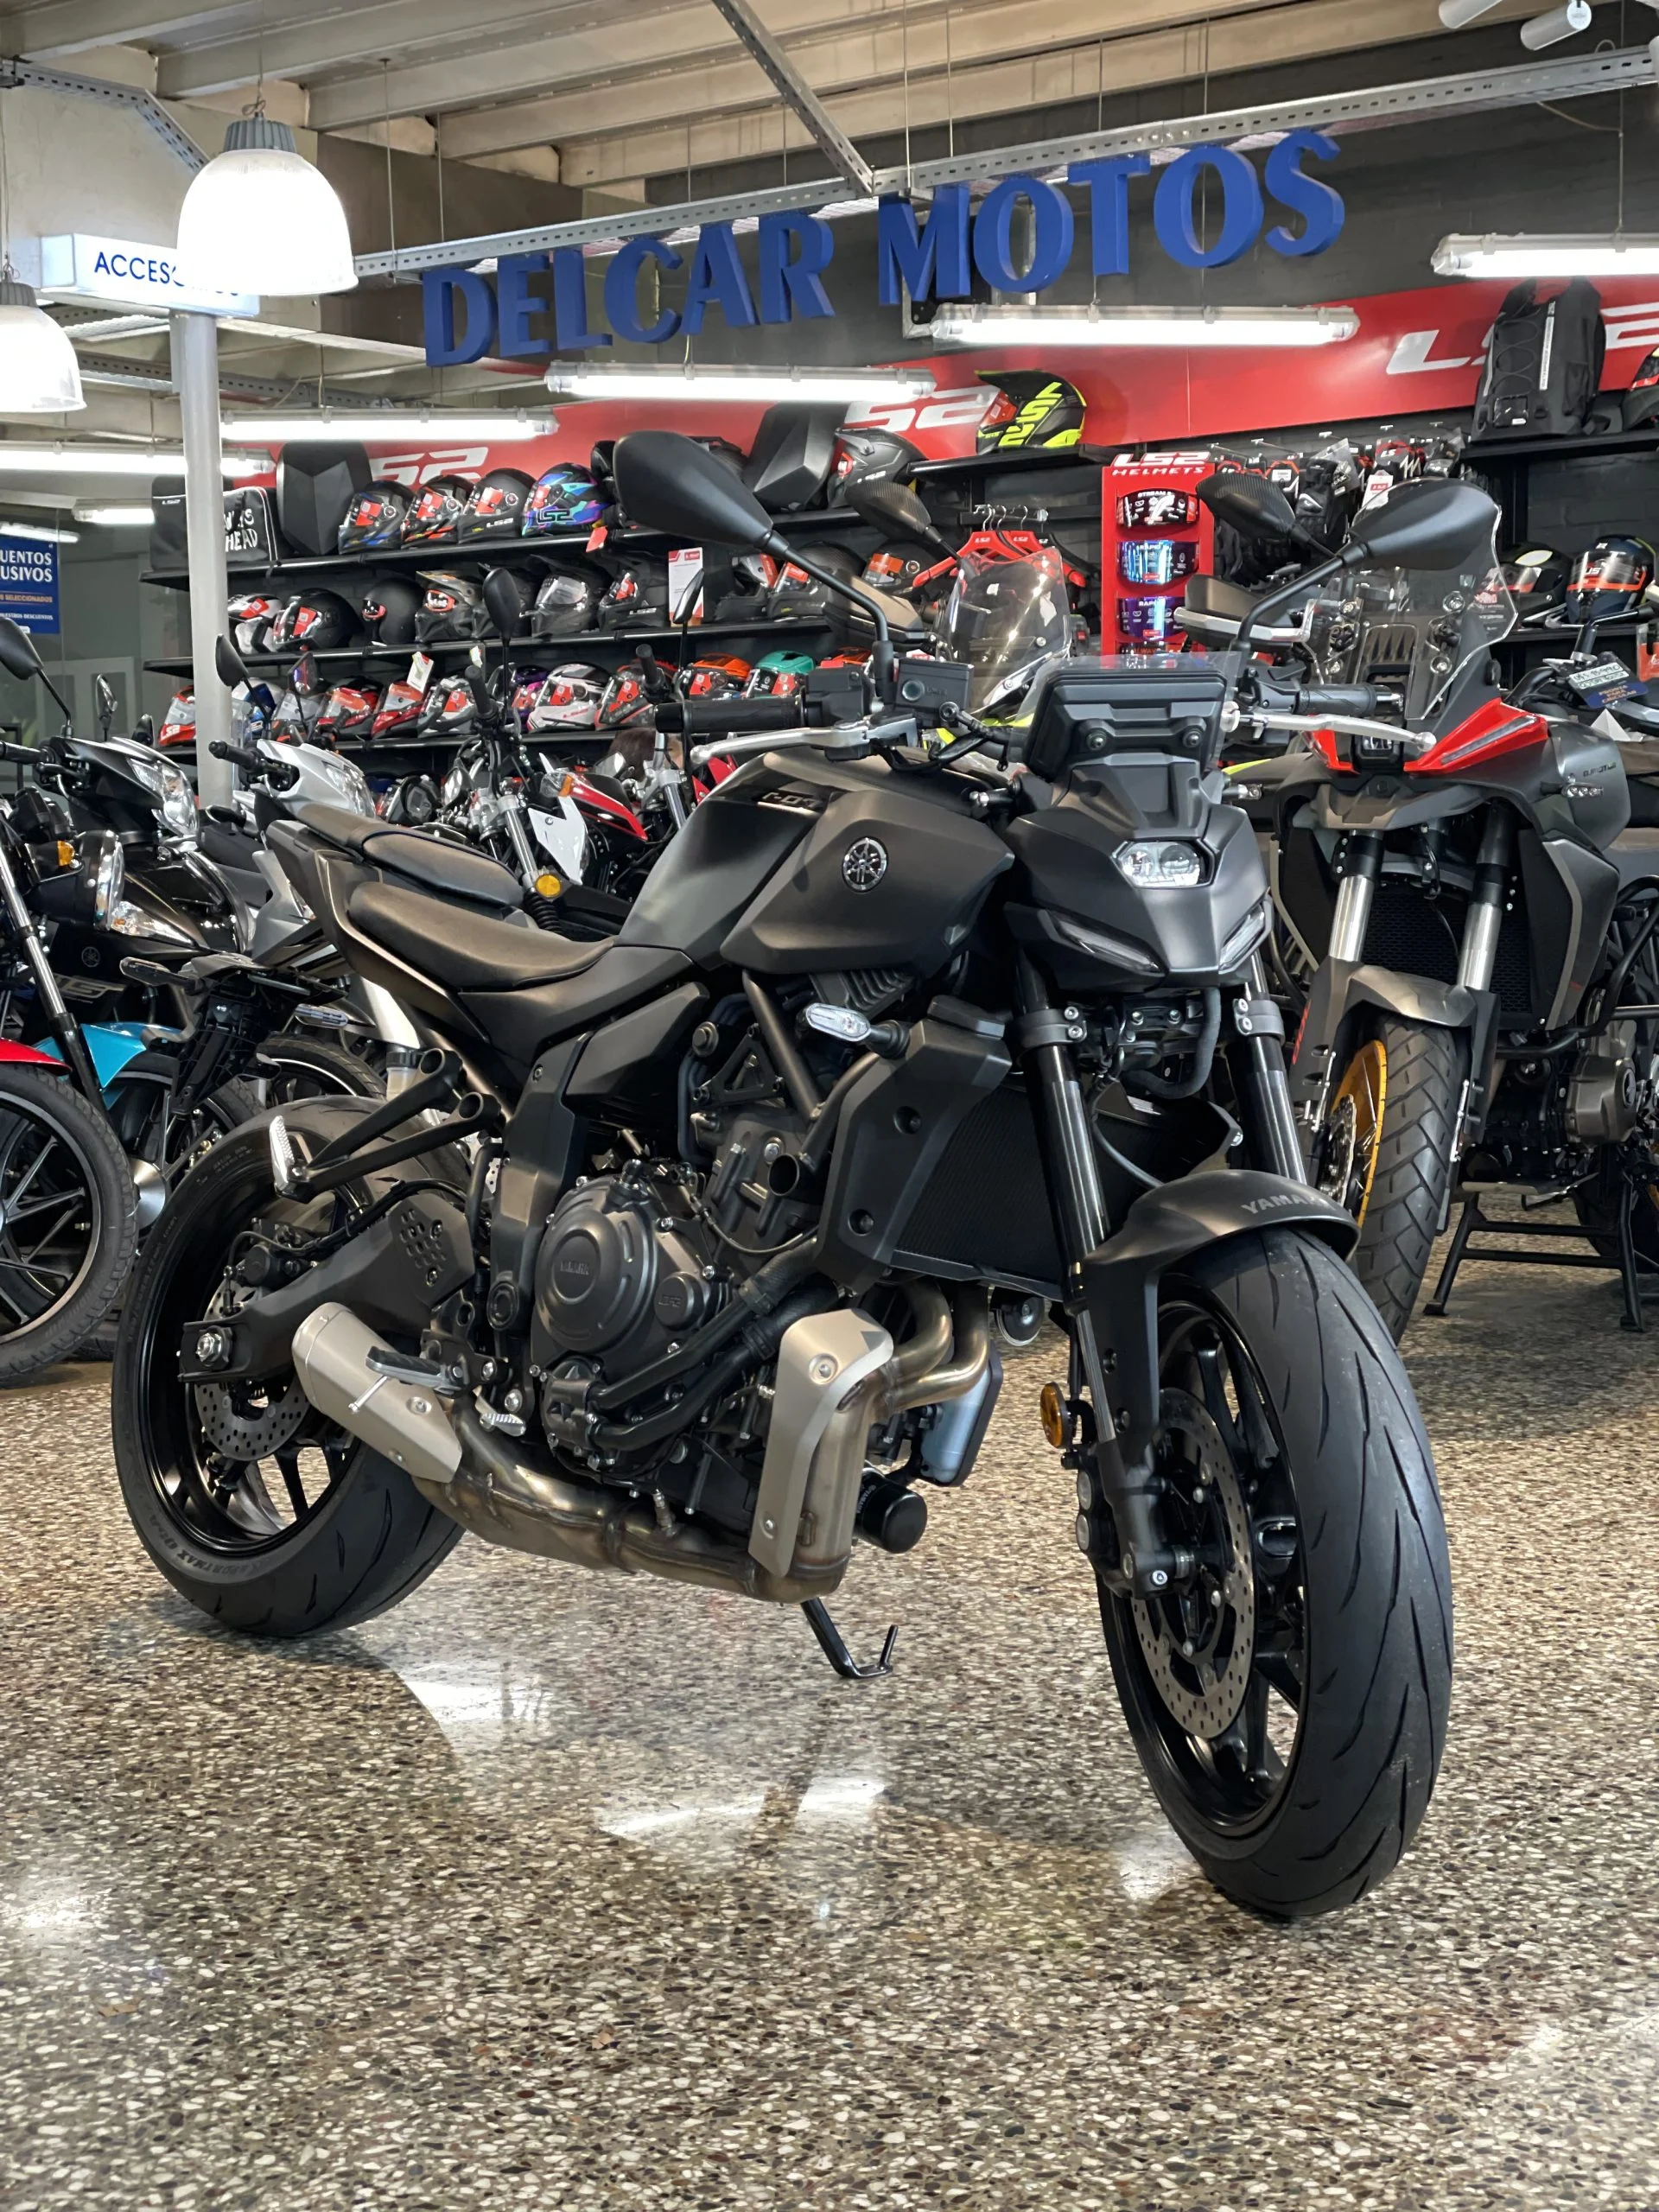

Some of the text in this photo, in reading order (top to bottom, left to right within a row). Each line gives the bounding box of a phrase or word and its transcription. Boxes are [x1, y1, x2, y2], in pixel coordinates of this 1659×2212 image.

[423, 129, 1344, 367] DELCAR MOTOS
[1112, 452, 1211, 467] LS2
[1112, 467, 1205, 476] HELMETS
[486, 518, 513, 528] LS2
